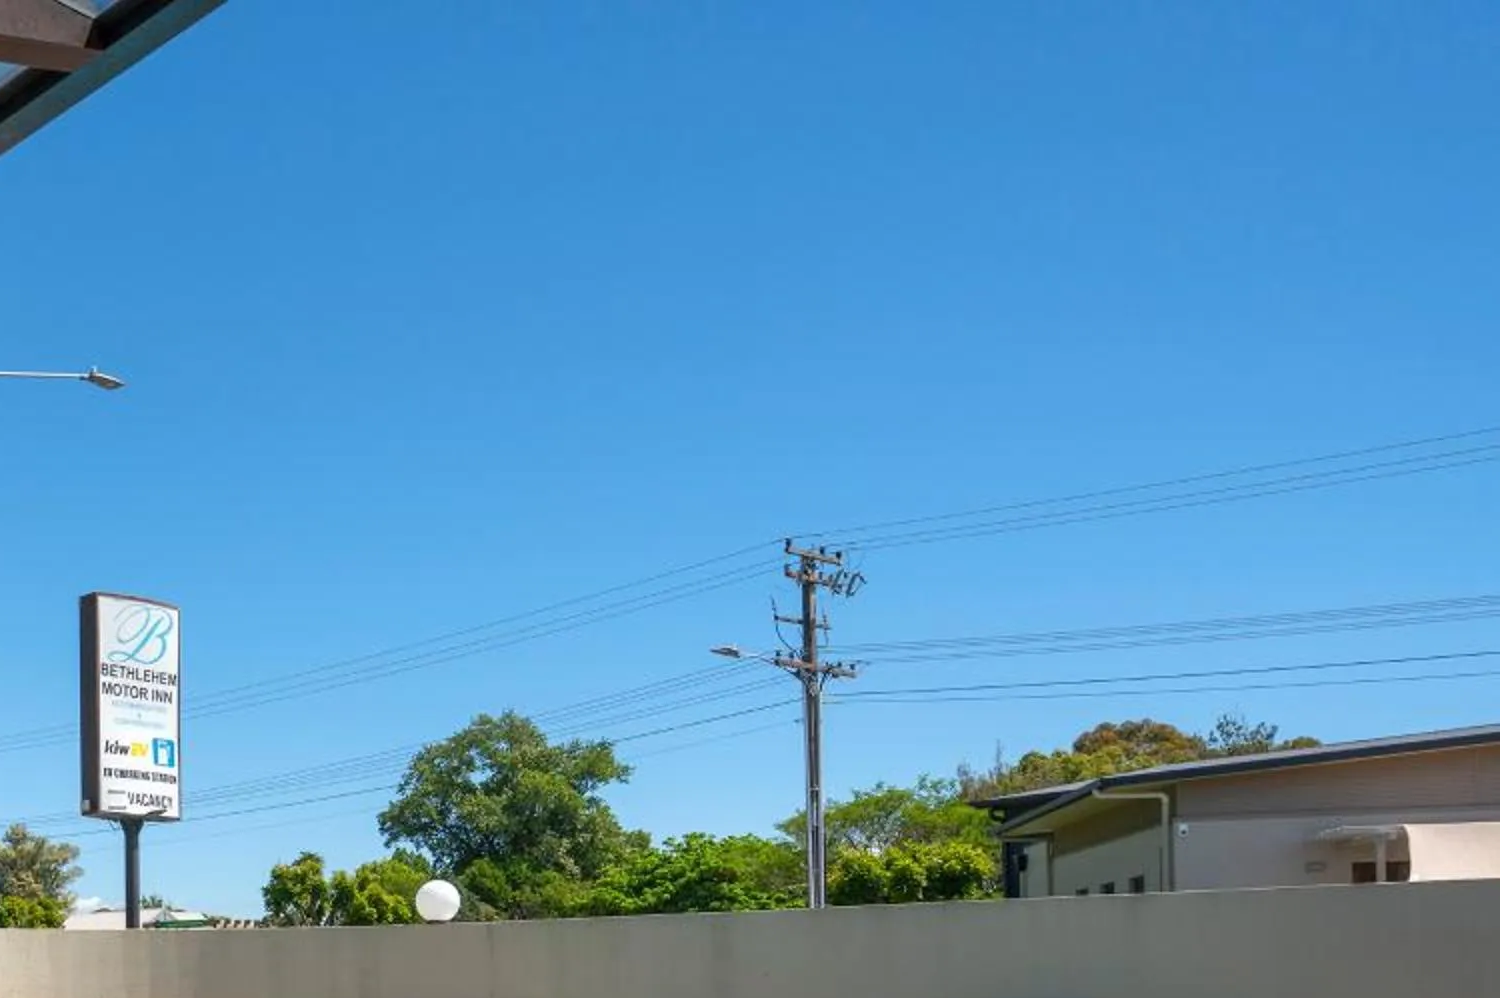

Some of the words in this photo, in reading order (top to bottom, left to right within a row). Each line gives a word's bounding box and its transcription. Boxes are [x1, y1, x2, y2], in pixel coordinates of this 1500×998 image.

[108, 604, 173, 665] B
[101, 663, 177, 687] BETHLEHEM
[101, 681, 149, 700] MOTOR
[152, 689, 173, 704] INN
[128, 792, 173, 809] VACANCY
